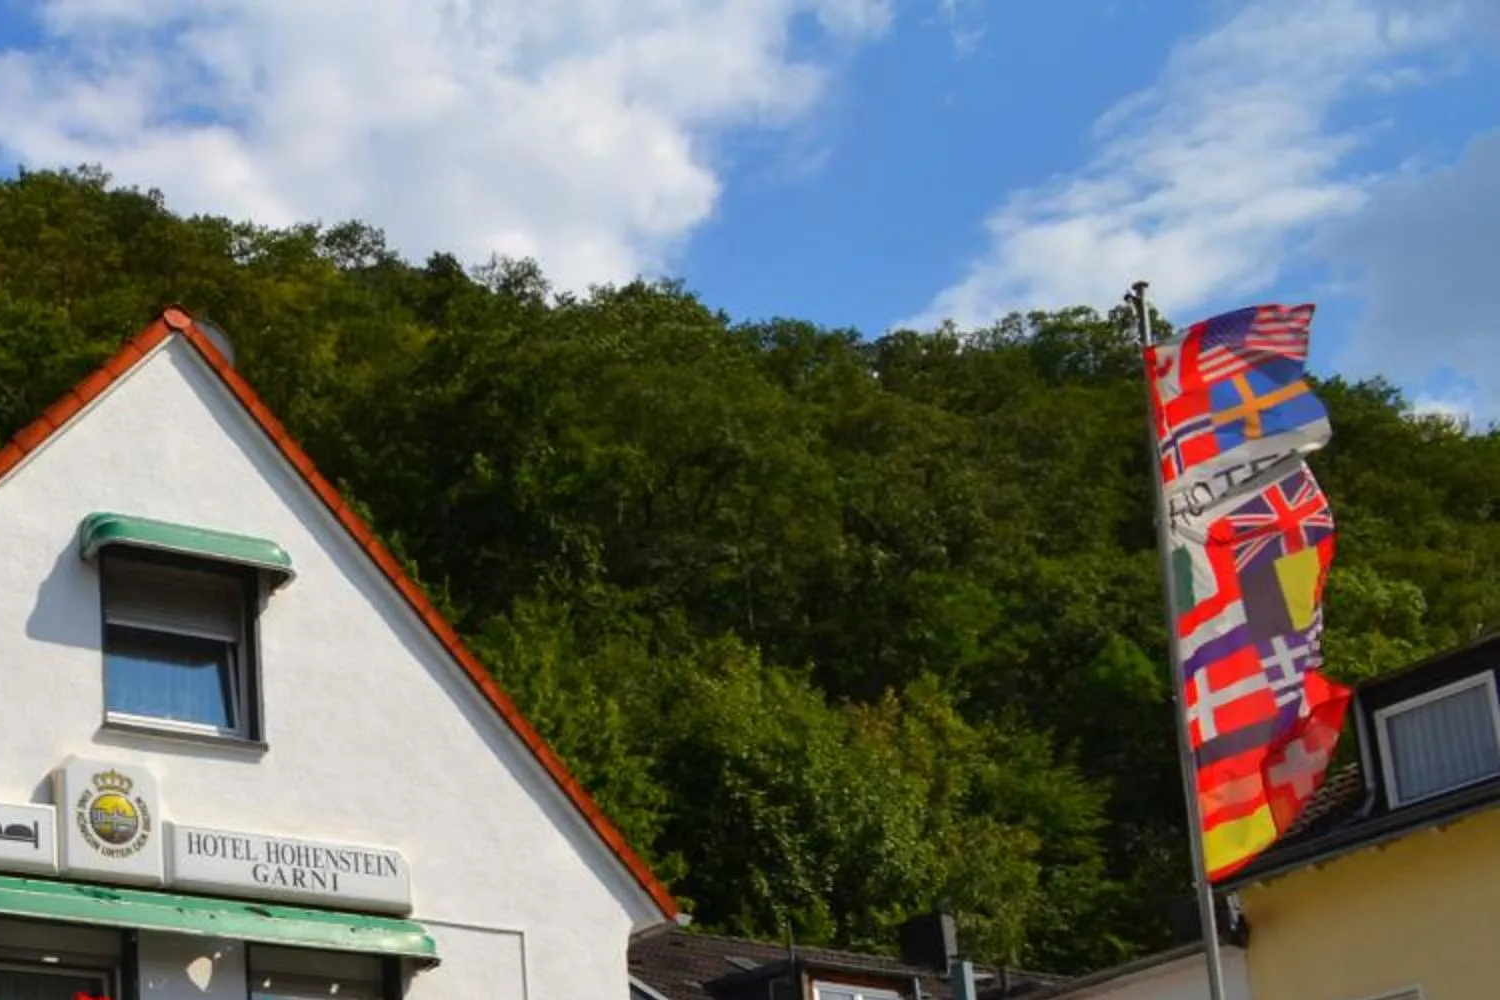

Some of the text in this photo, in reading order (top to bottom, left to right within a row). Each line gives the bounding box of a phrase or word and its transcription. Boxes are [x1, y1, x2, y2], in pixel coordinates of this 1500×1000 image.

[187, 831, 399, 878] HOTEL HOHENSTEIN
[251, 863, 339, 892] GARNI
